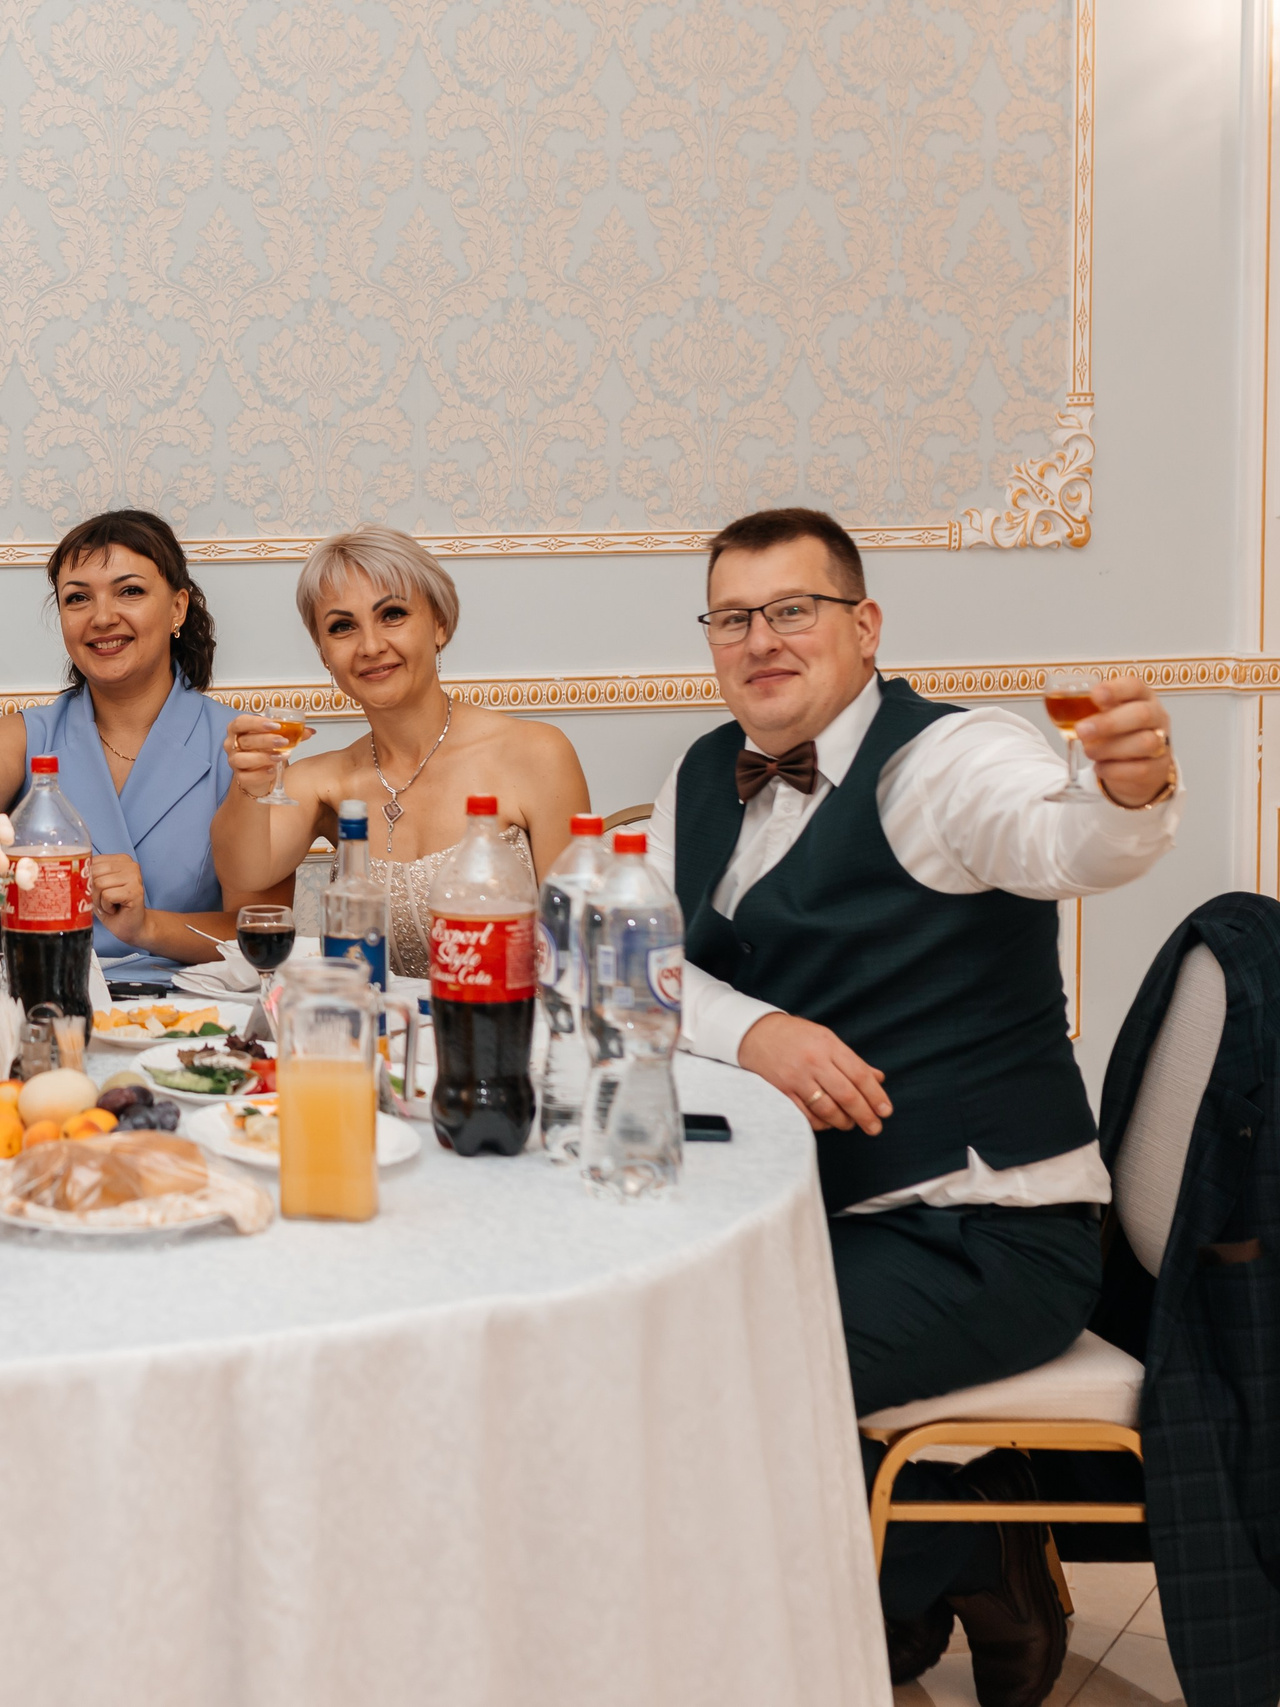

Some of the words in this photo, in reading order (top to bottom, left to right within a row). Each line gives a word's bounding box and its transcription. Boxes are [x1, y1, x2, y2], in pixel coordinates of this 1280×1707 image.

[432, 918, 495, 946] Export
[436, 942, 482, 972] Style
[458, 966, 493, 985] Cola
